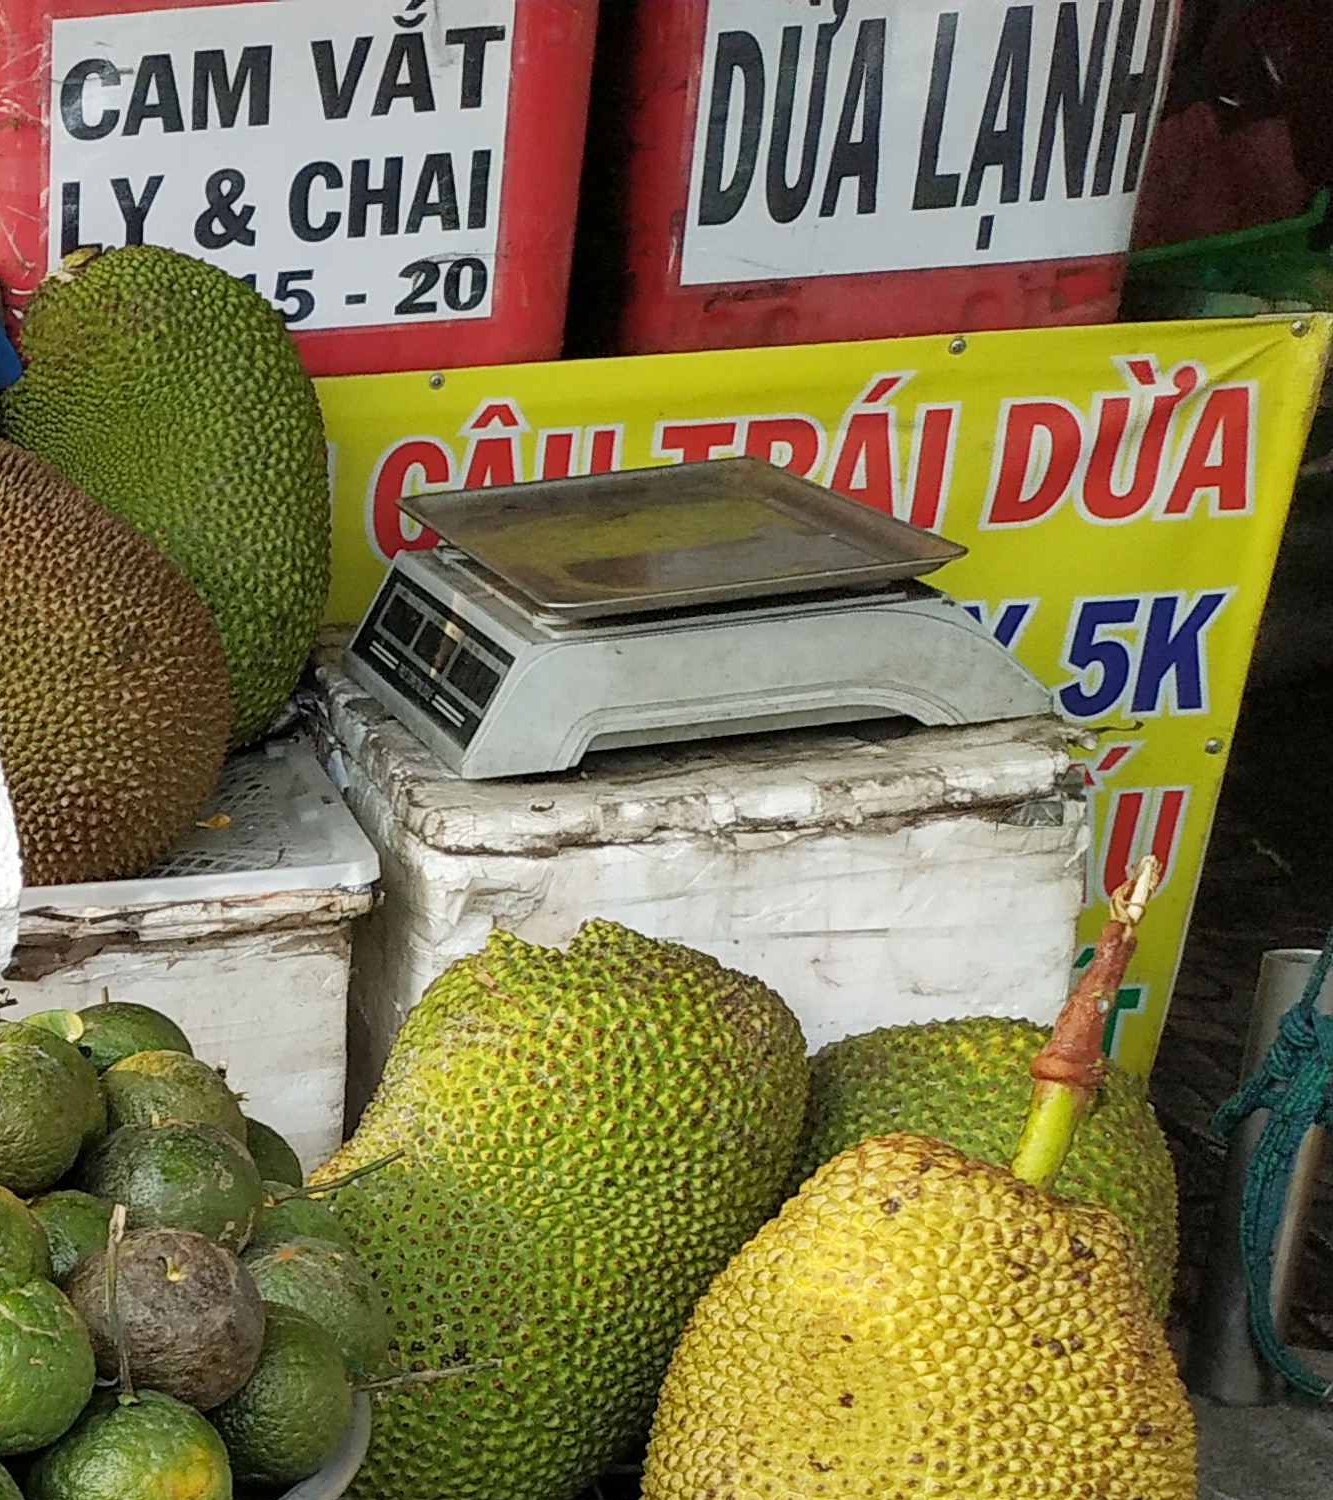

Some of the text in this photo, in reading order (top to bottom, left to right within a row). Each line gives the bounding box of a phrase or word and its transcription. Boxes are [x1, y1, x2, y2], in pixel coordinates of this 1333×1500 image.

[60, 0, 506, 142] CAM VẮT
[911, 0, 1165, 250] LẠNH
[60, 149, 493, 260] LY & CHAI
[394, 257, 489, 316] 20
[988, 359, 1252, 527] DỪA
[1059, 592, 1227, 717] 5K
